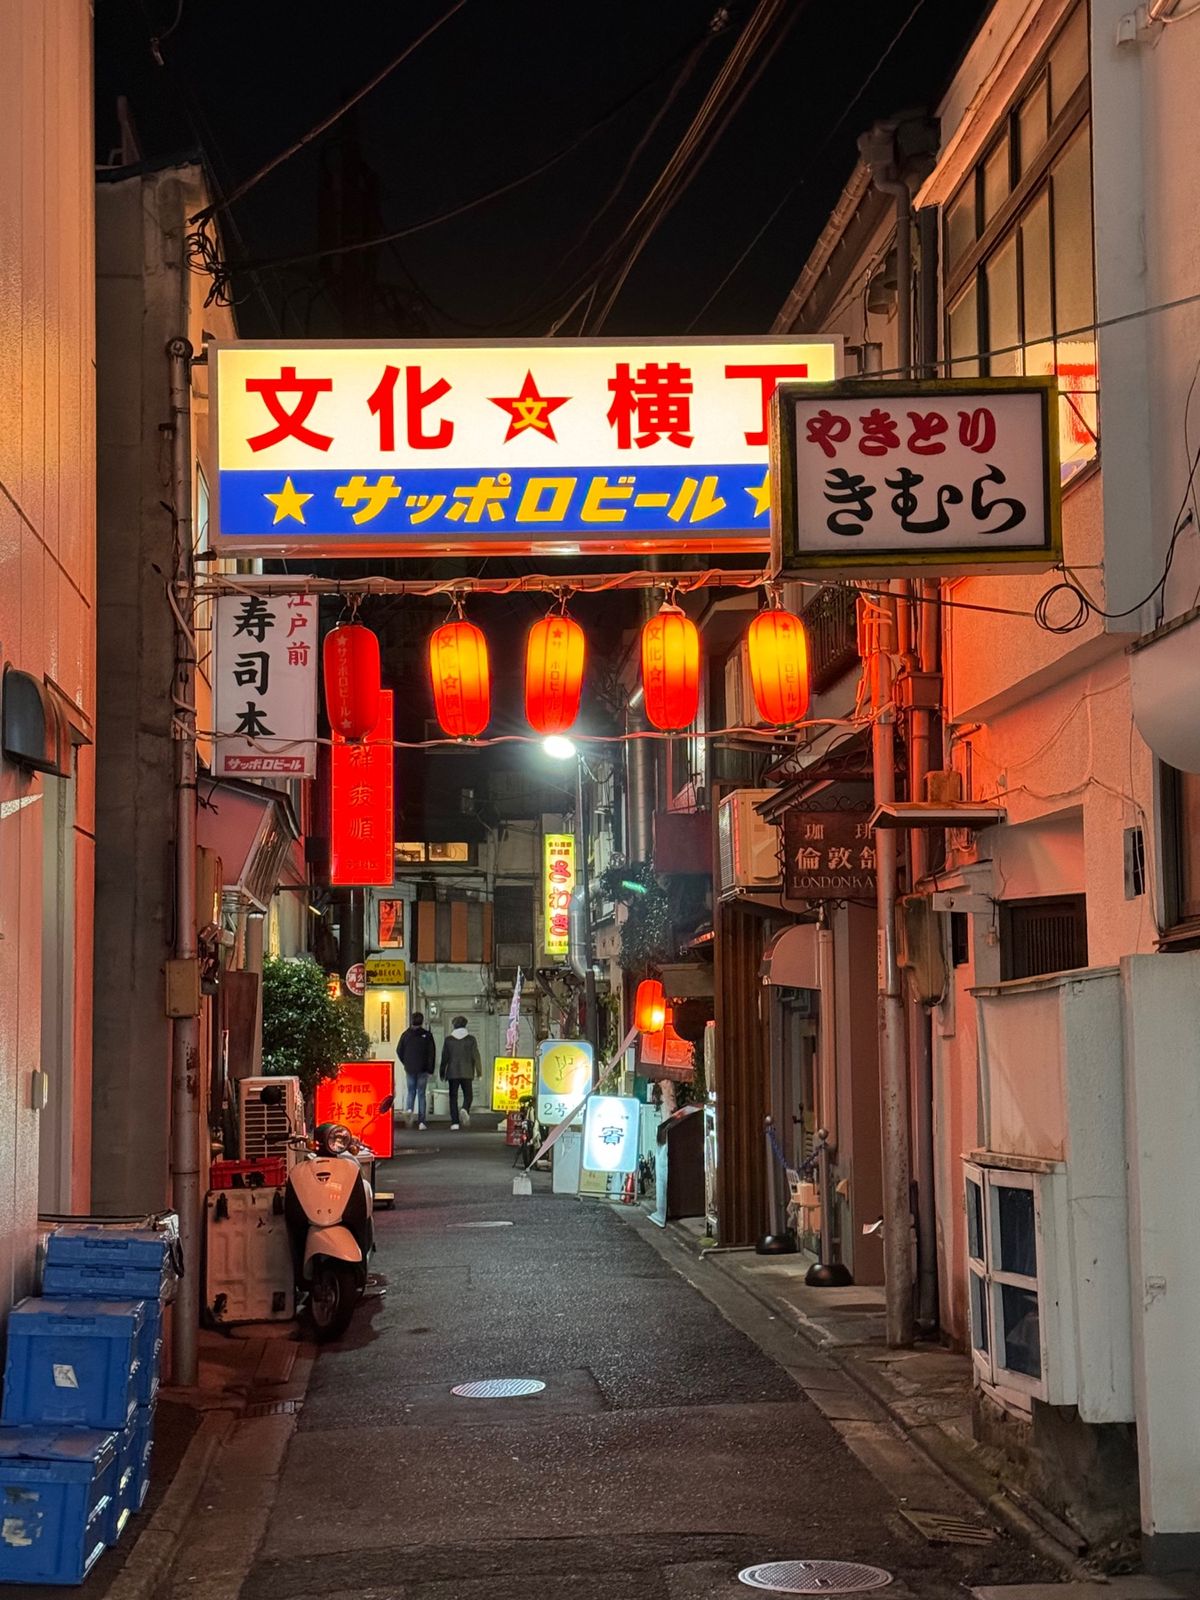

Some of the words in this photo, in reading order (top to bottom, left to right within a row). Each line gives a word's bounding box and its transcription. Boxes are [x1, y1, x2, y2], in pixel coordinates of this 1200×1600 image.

[245, 364, 455, 454] 文化
[512, 397, 549, 431] 文
[605, 362, 808, 450] 横丁
[805, 407, 997, 459] やきとり
[333, 471, 728, 527] サッポロビール
[823, 463, 1027, 537] きむら
[227, 757, 303, 772] サッポロビール
